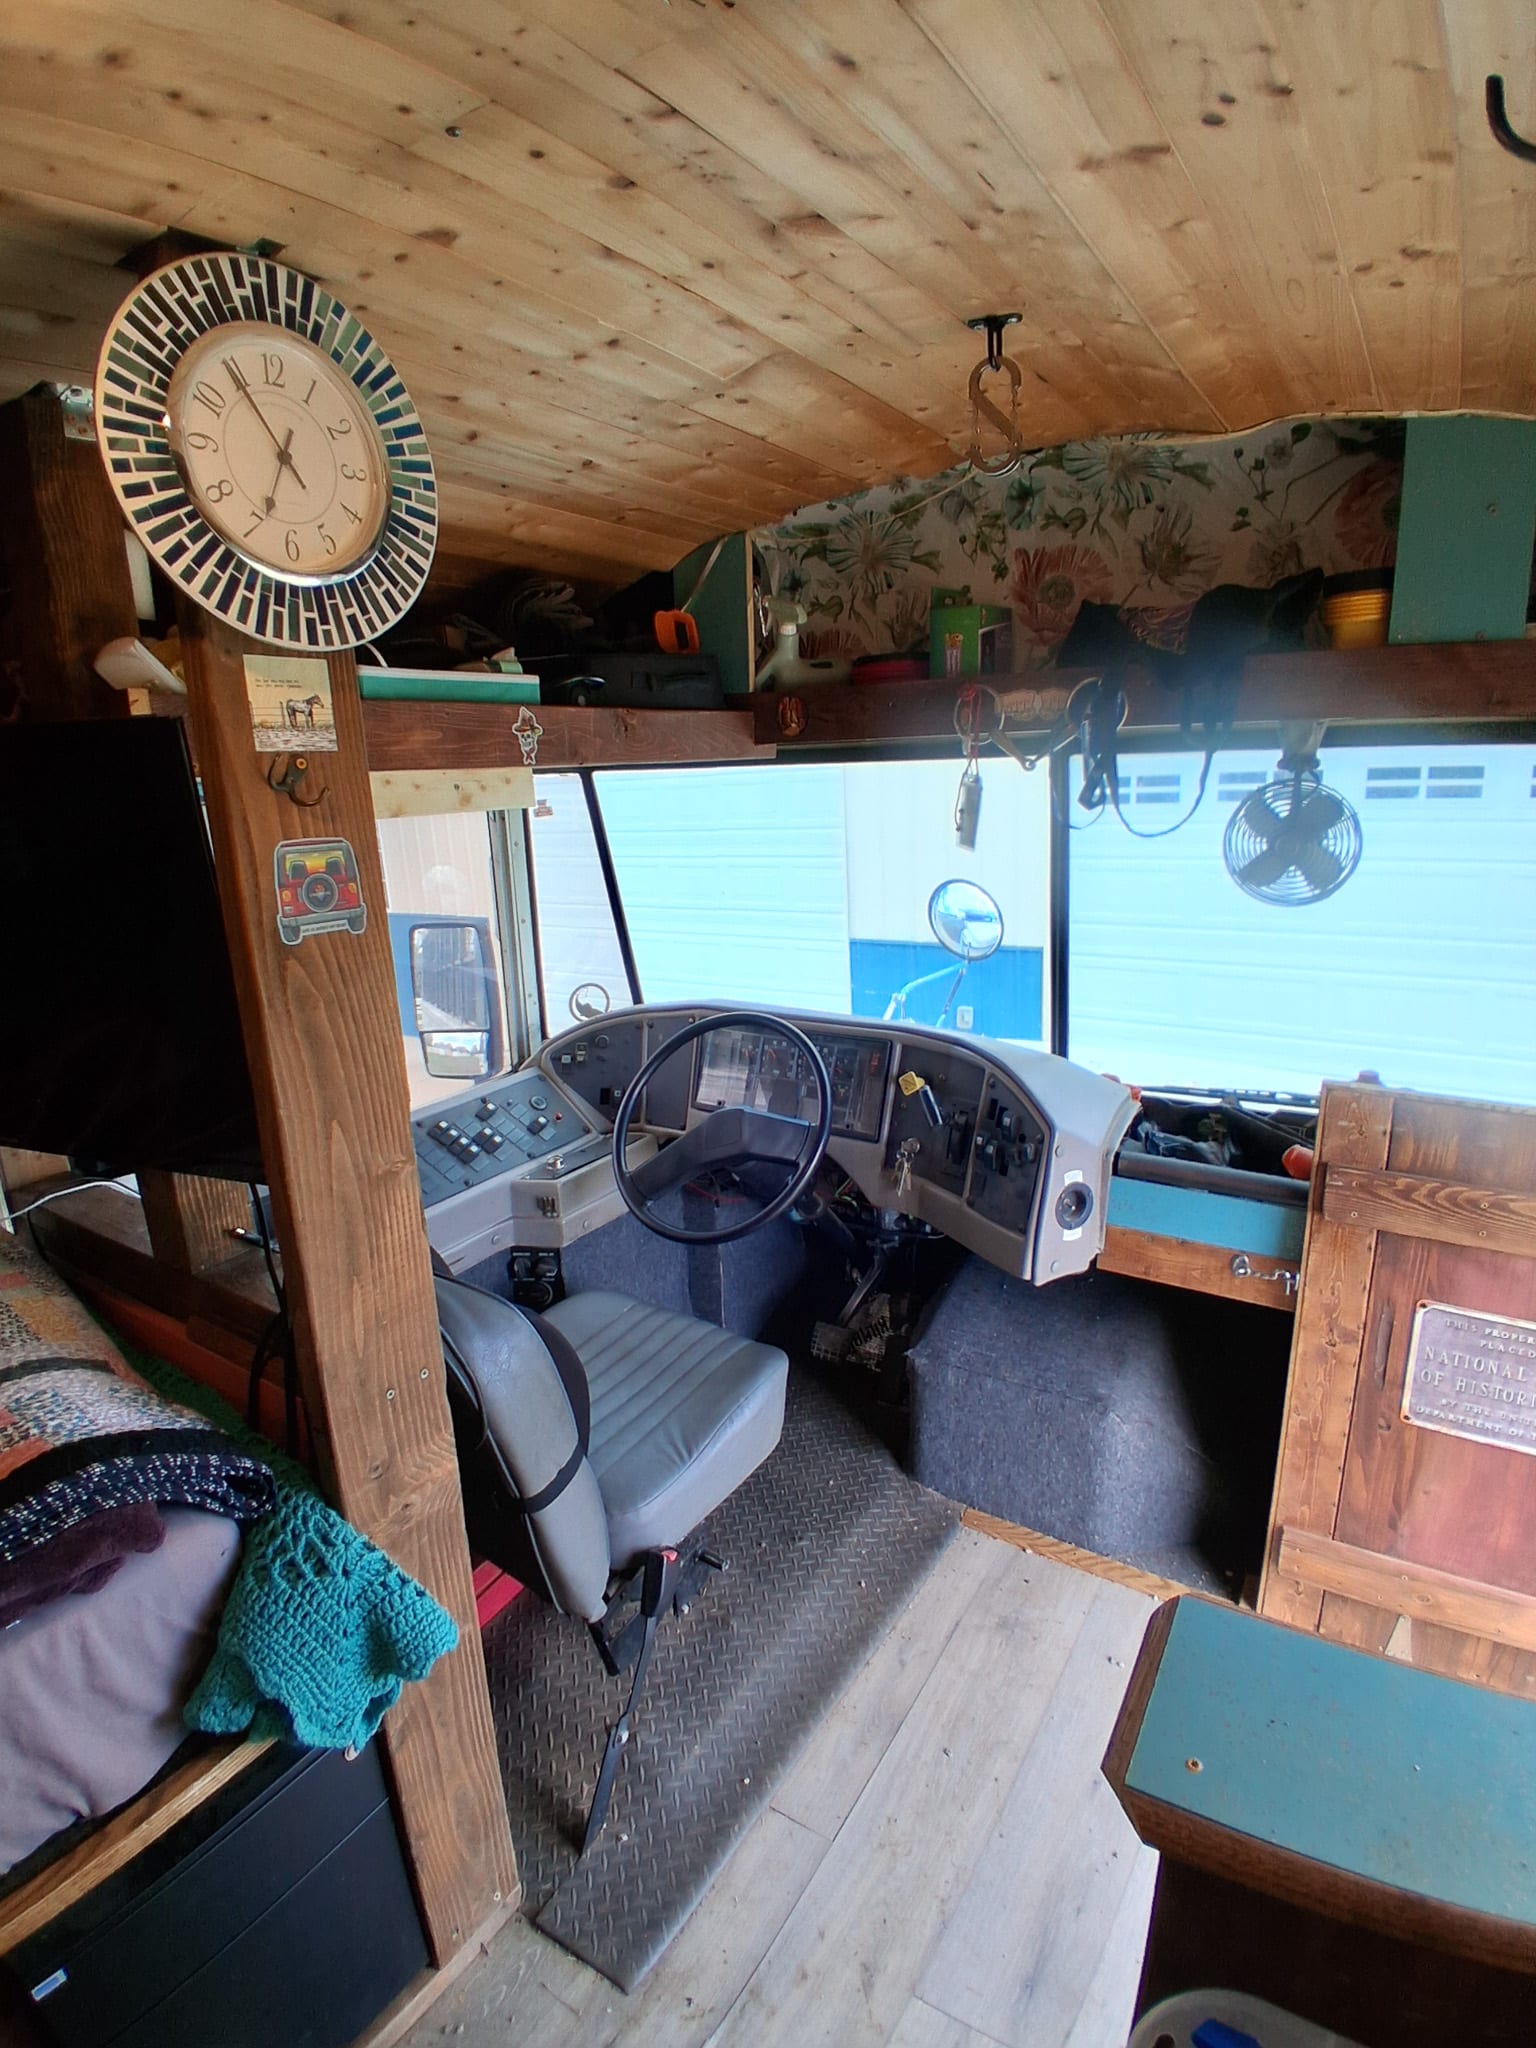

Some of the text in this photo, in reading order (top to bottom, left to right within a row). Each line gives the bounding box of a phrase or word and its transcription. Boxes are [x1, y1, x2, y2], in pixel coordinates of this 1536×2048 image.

[222, 356, 251, 391] 11
[260, 352, 286, 389] 12
[192, 380, 227, 420] 10
[302, 379, 317, 407] 1
[187, 432, 219, 453] 9
[327, 418, 352, 441] 2
[341, 463, 367, 482] 3
[205, 479, 234, 503] 8
[243, 509, 267, 538] 7
[340, 501, 363, 527] 4
[285, 529, 300, 562] 6
[317, 523, 337, 556] 5
[1446, 1319, 1477, 1332] THIS
[1480, 1339, 1536, 1359] PLACED
[1424, 1346, 1528, 1382] NATIONAL
[1420, 1369, 1445, 1387] OF
[1416, 1405, 1502, 1433] DEPARTMENT
[1508, 1428, 1524, 1438] OF
[1441, 1399, 1457, 1408] BY
[1464, 1402, 1491, 1417] THE
